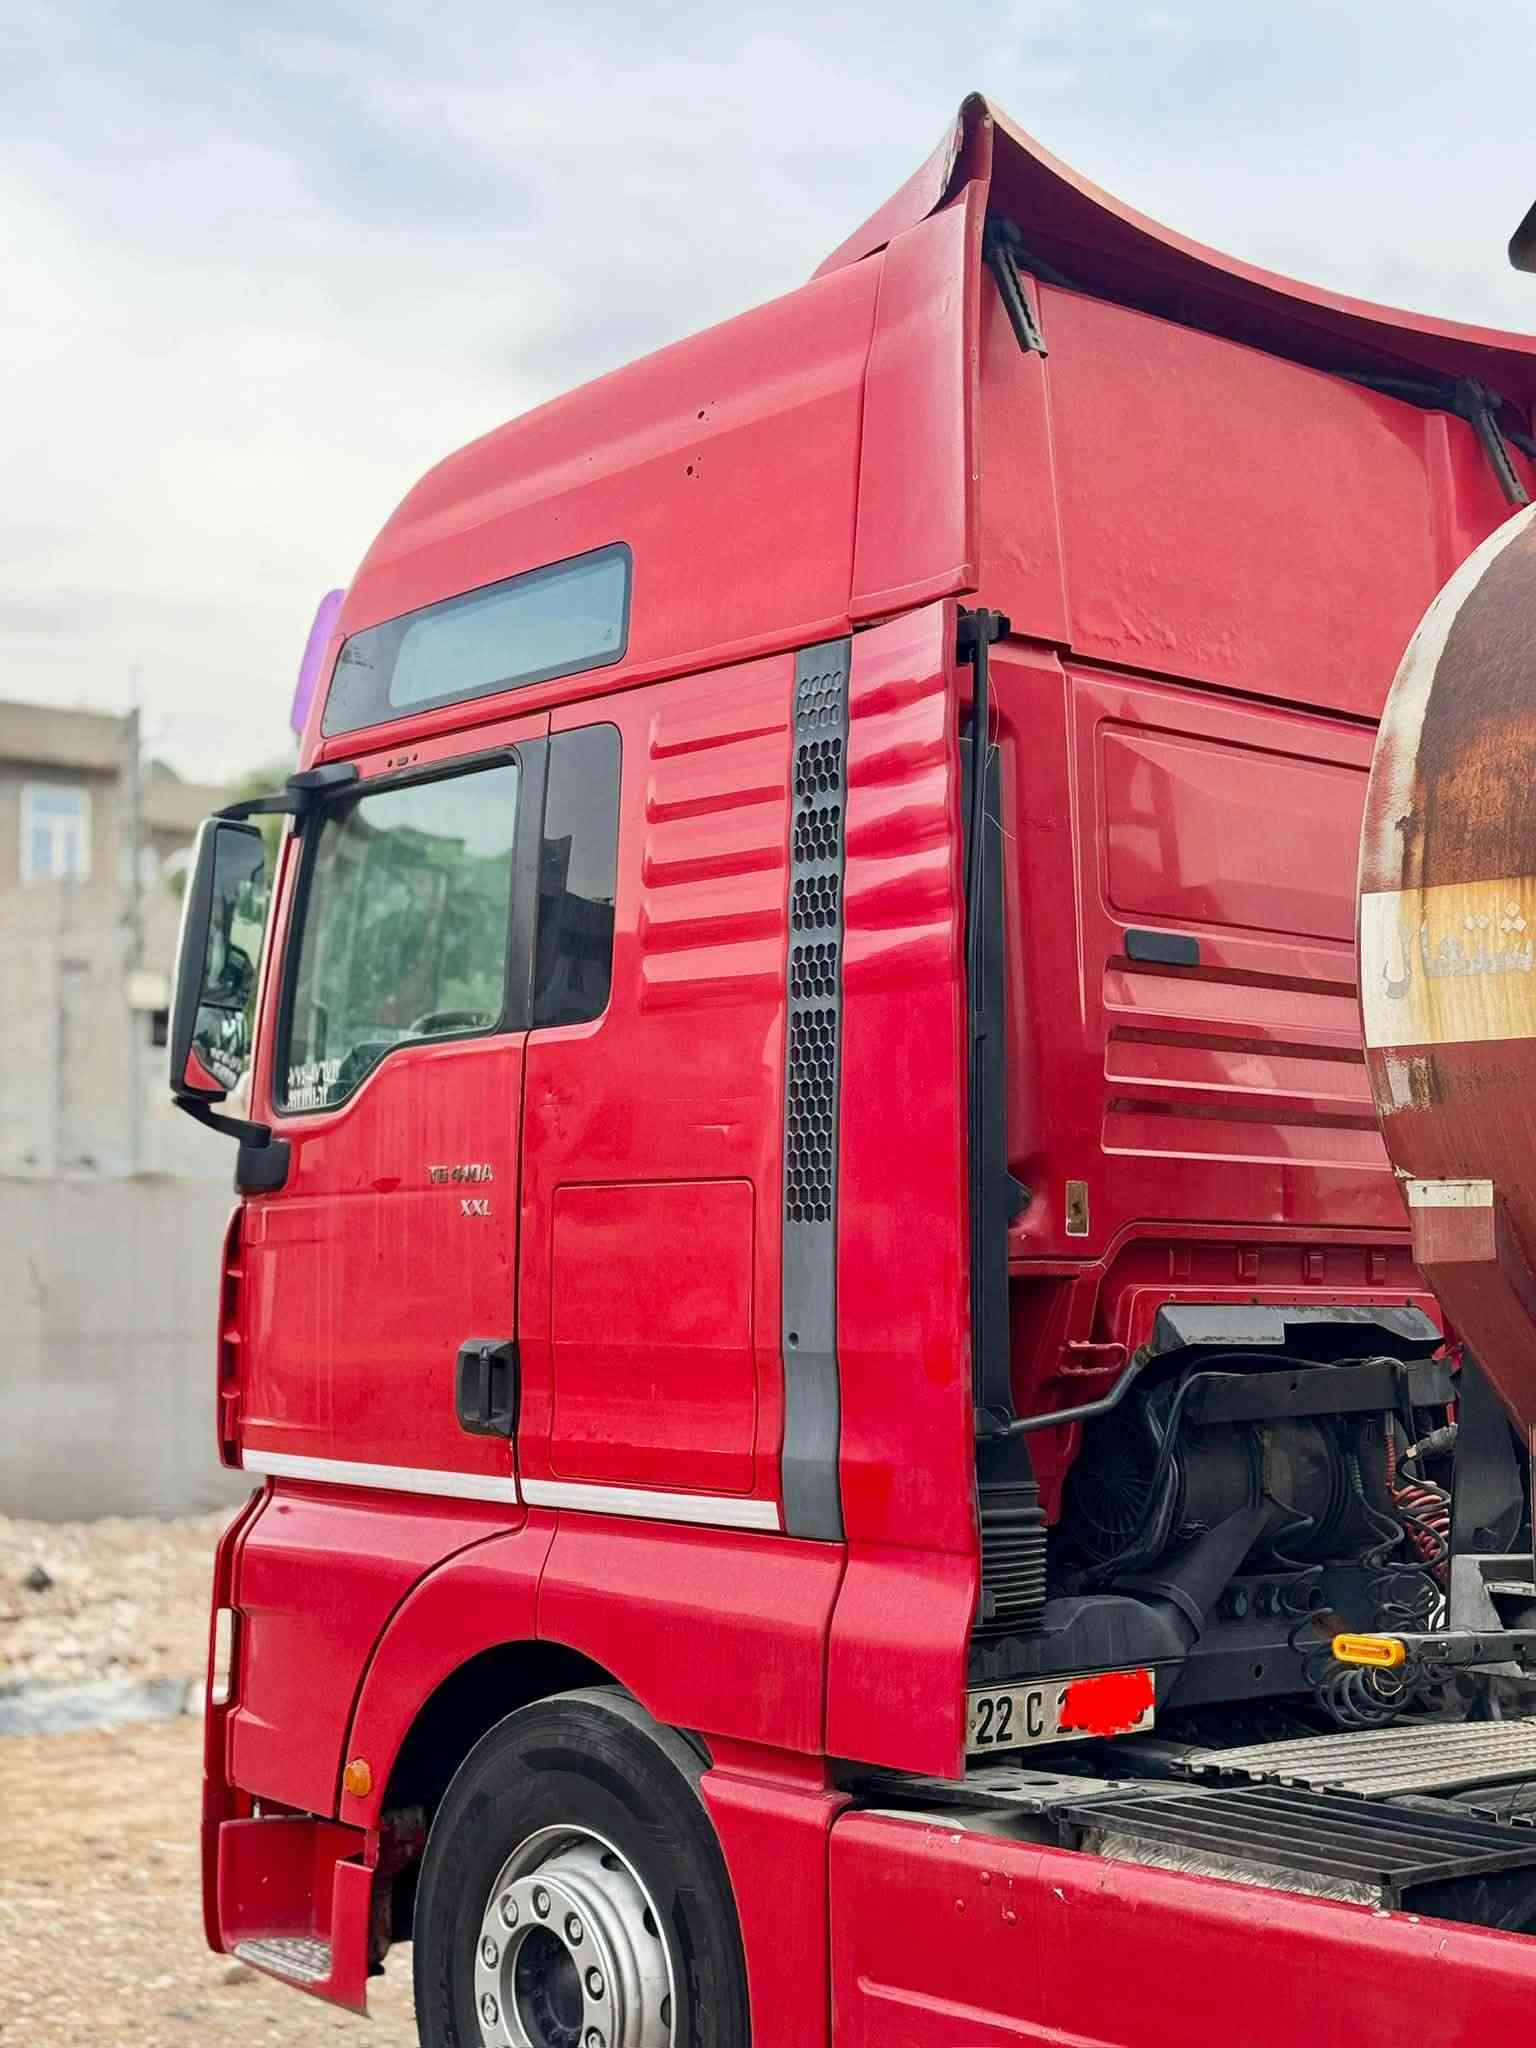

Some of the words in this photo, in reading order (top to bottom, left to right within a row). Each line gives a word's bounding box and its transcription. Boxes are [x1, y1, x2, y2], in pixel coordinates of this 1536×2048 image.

[460, 1199, 493, 1217] XXL
[976, 1696, 1013, 1745] 22
[1026, 1691, 1044, 1738] C
